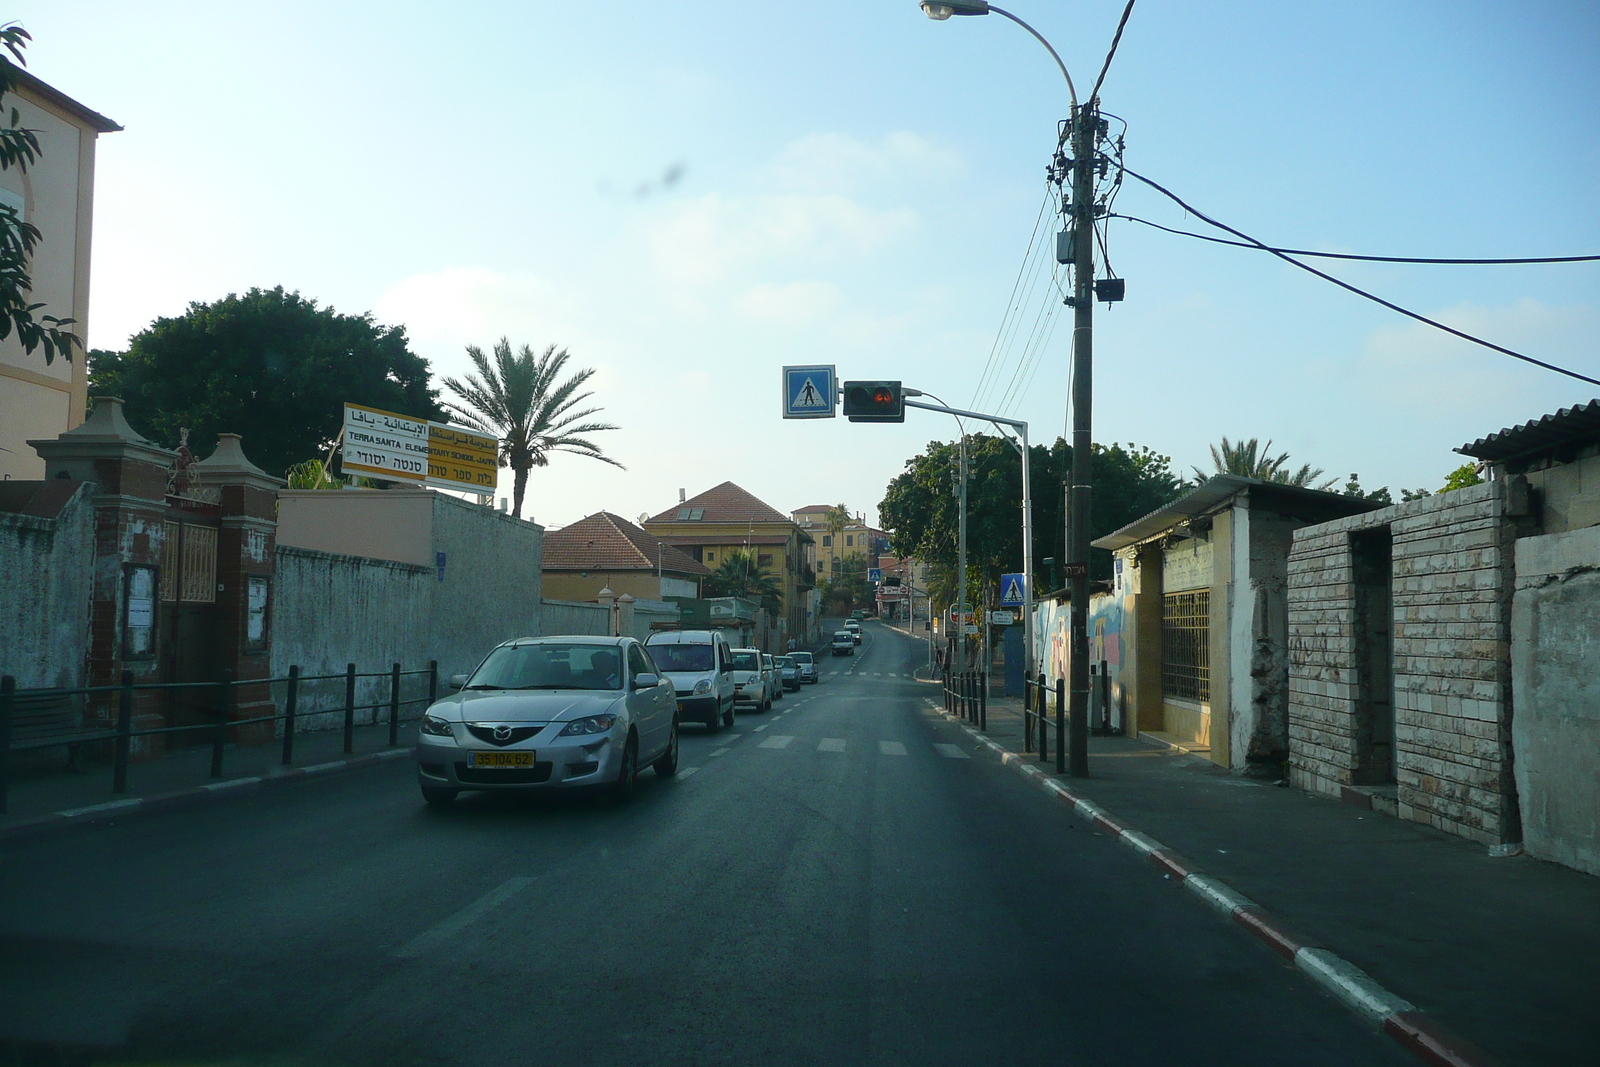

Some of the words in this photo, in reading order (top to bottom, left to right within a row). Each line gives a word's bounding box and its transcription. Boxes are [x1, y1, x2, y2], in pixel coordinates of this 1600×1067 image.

[351, 410, 375, 428] يافا
[349, 431, 374, 444] TERRA
[375, 437, 401, 449] SANTA
[405, 443, 450, 458] ELEMENTARY
[469, 435, 495, 450] مدرسة
[357, 450, 386, 465] יסודי
[393, 457, 422, 472] סנטה
[428, 463, 447, 476] טרה
[453, 468, 472, 480] ספר
[477, 472, 492, 484] בית
[478, 754, 490, 765] 35
[494, 753, 512, 765] 104
[515, 753, 529, 765] 62
